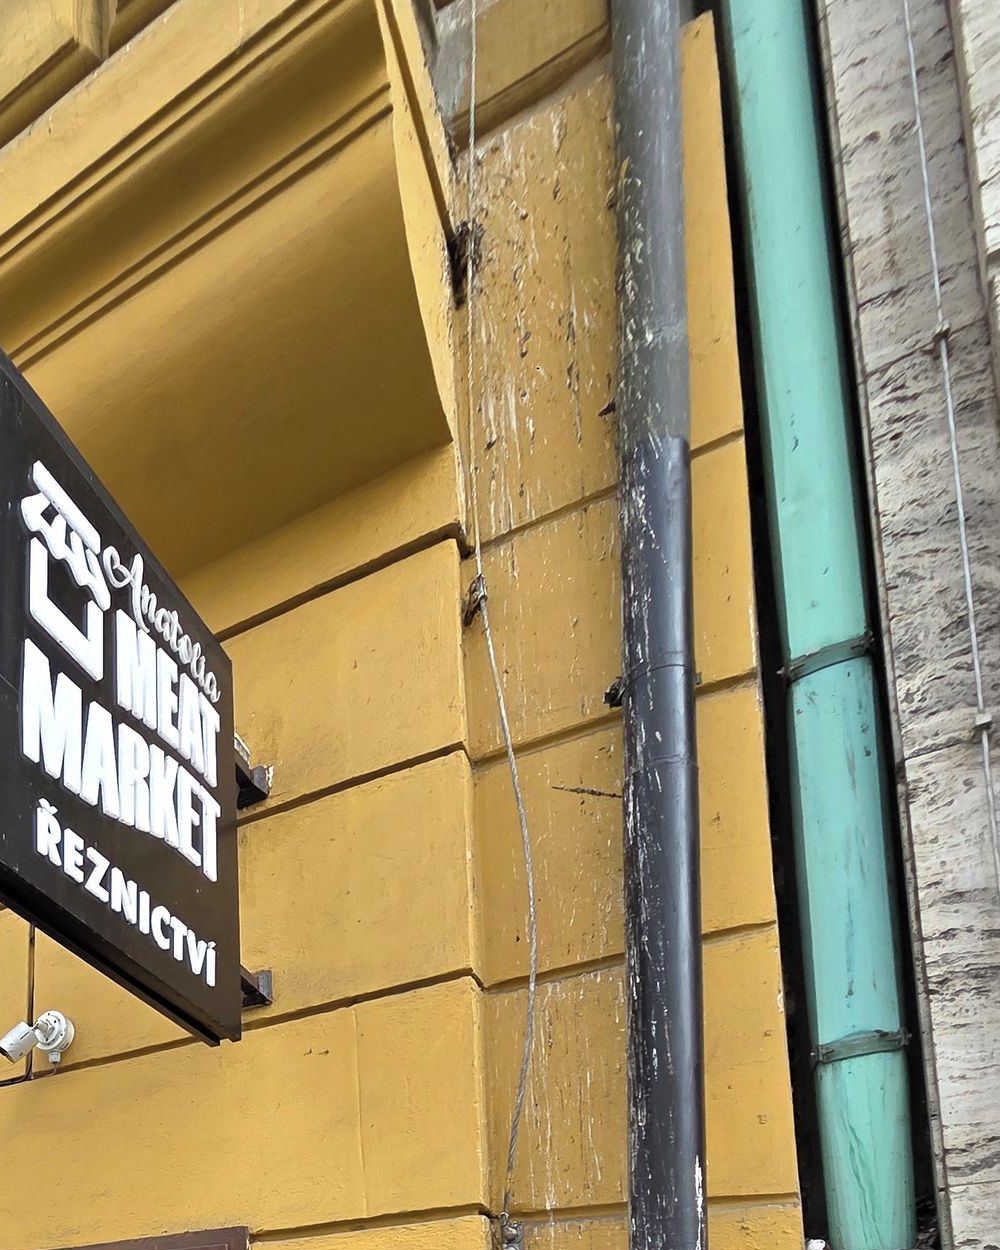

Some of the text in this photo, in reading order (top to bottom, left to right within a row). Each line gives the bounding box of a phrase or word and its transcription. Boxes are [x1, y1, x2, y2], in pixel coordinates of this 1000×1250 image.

[103, 545, 221, 702] Anatolia
[116, 608, 220, 788] MEAT
[21, 637, 220, 883] MARKET
[35, 797, 217, 987] ŘEZNICTVÍ
